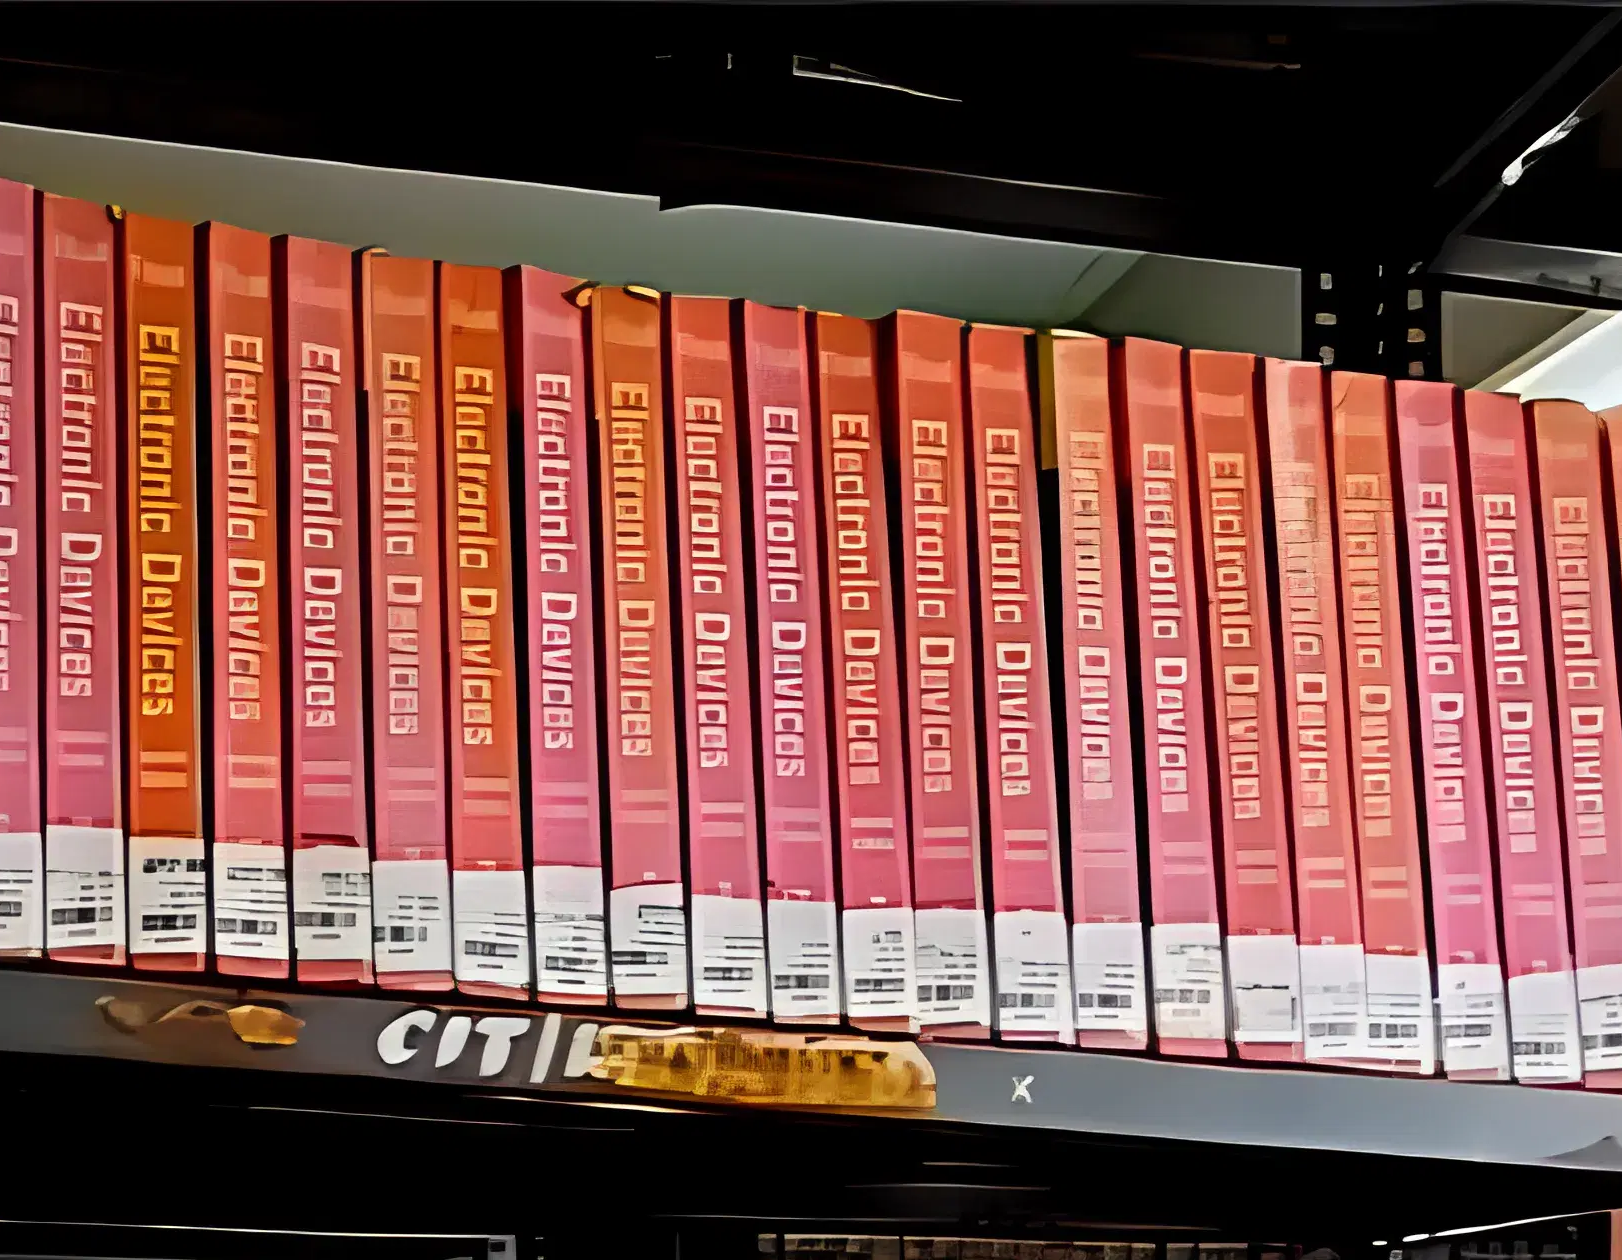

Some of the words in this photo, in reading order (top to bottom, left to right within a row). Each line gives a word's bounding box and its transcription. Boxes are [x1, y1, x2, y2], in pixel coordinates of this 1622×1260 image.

[59, 301, 103, 513] Electronic
[301, 341, 344, 549] Electronic
[536, 373, 578, 574] Electronic
[59, 531, 105, 697] Devices
[141, 553, 183, 717] Devices
[303, 567, 344, 728] Devices
[540, 591, 579, 749] Devices
[1430, 692, 1468, 843] Devic
[1500, 702, 1538, 854] Devic
[1570, 706, 1608, 857] Devic
